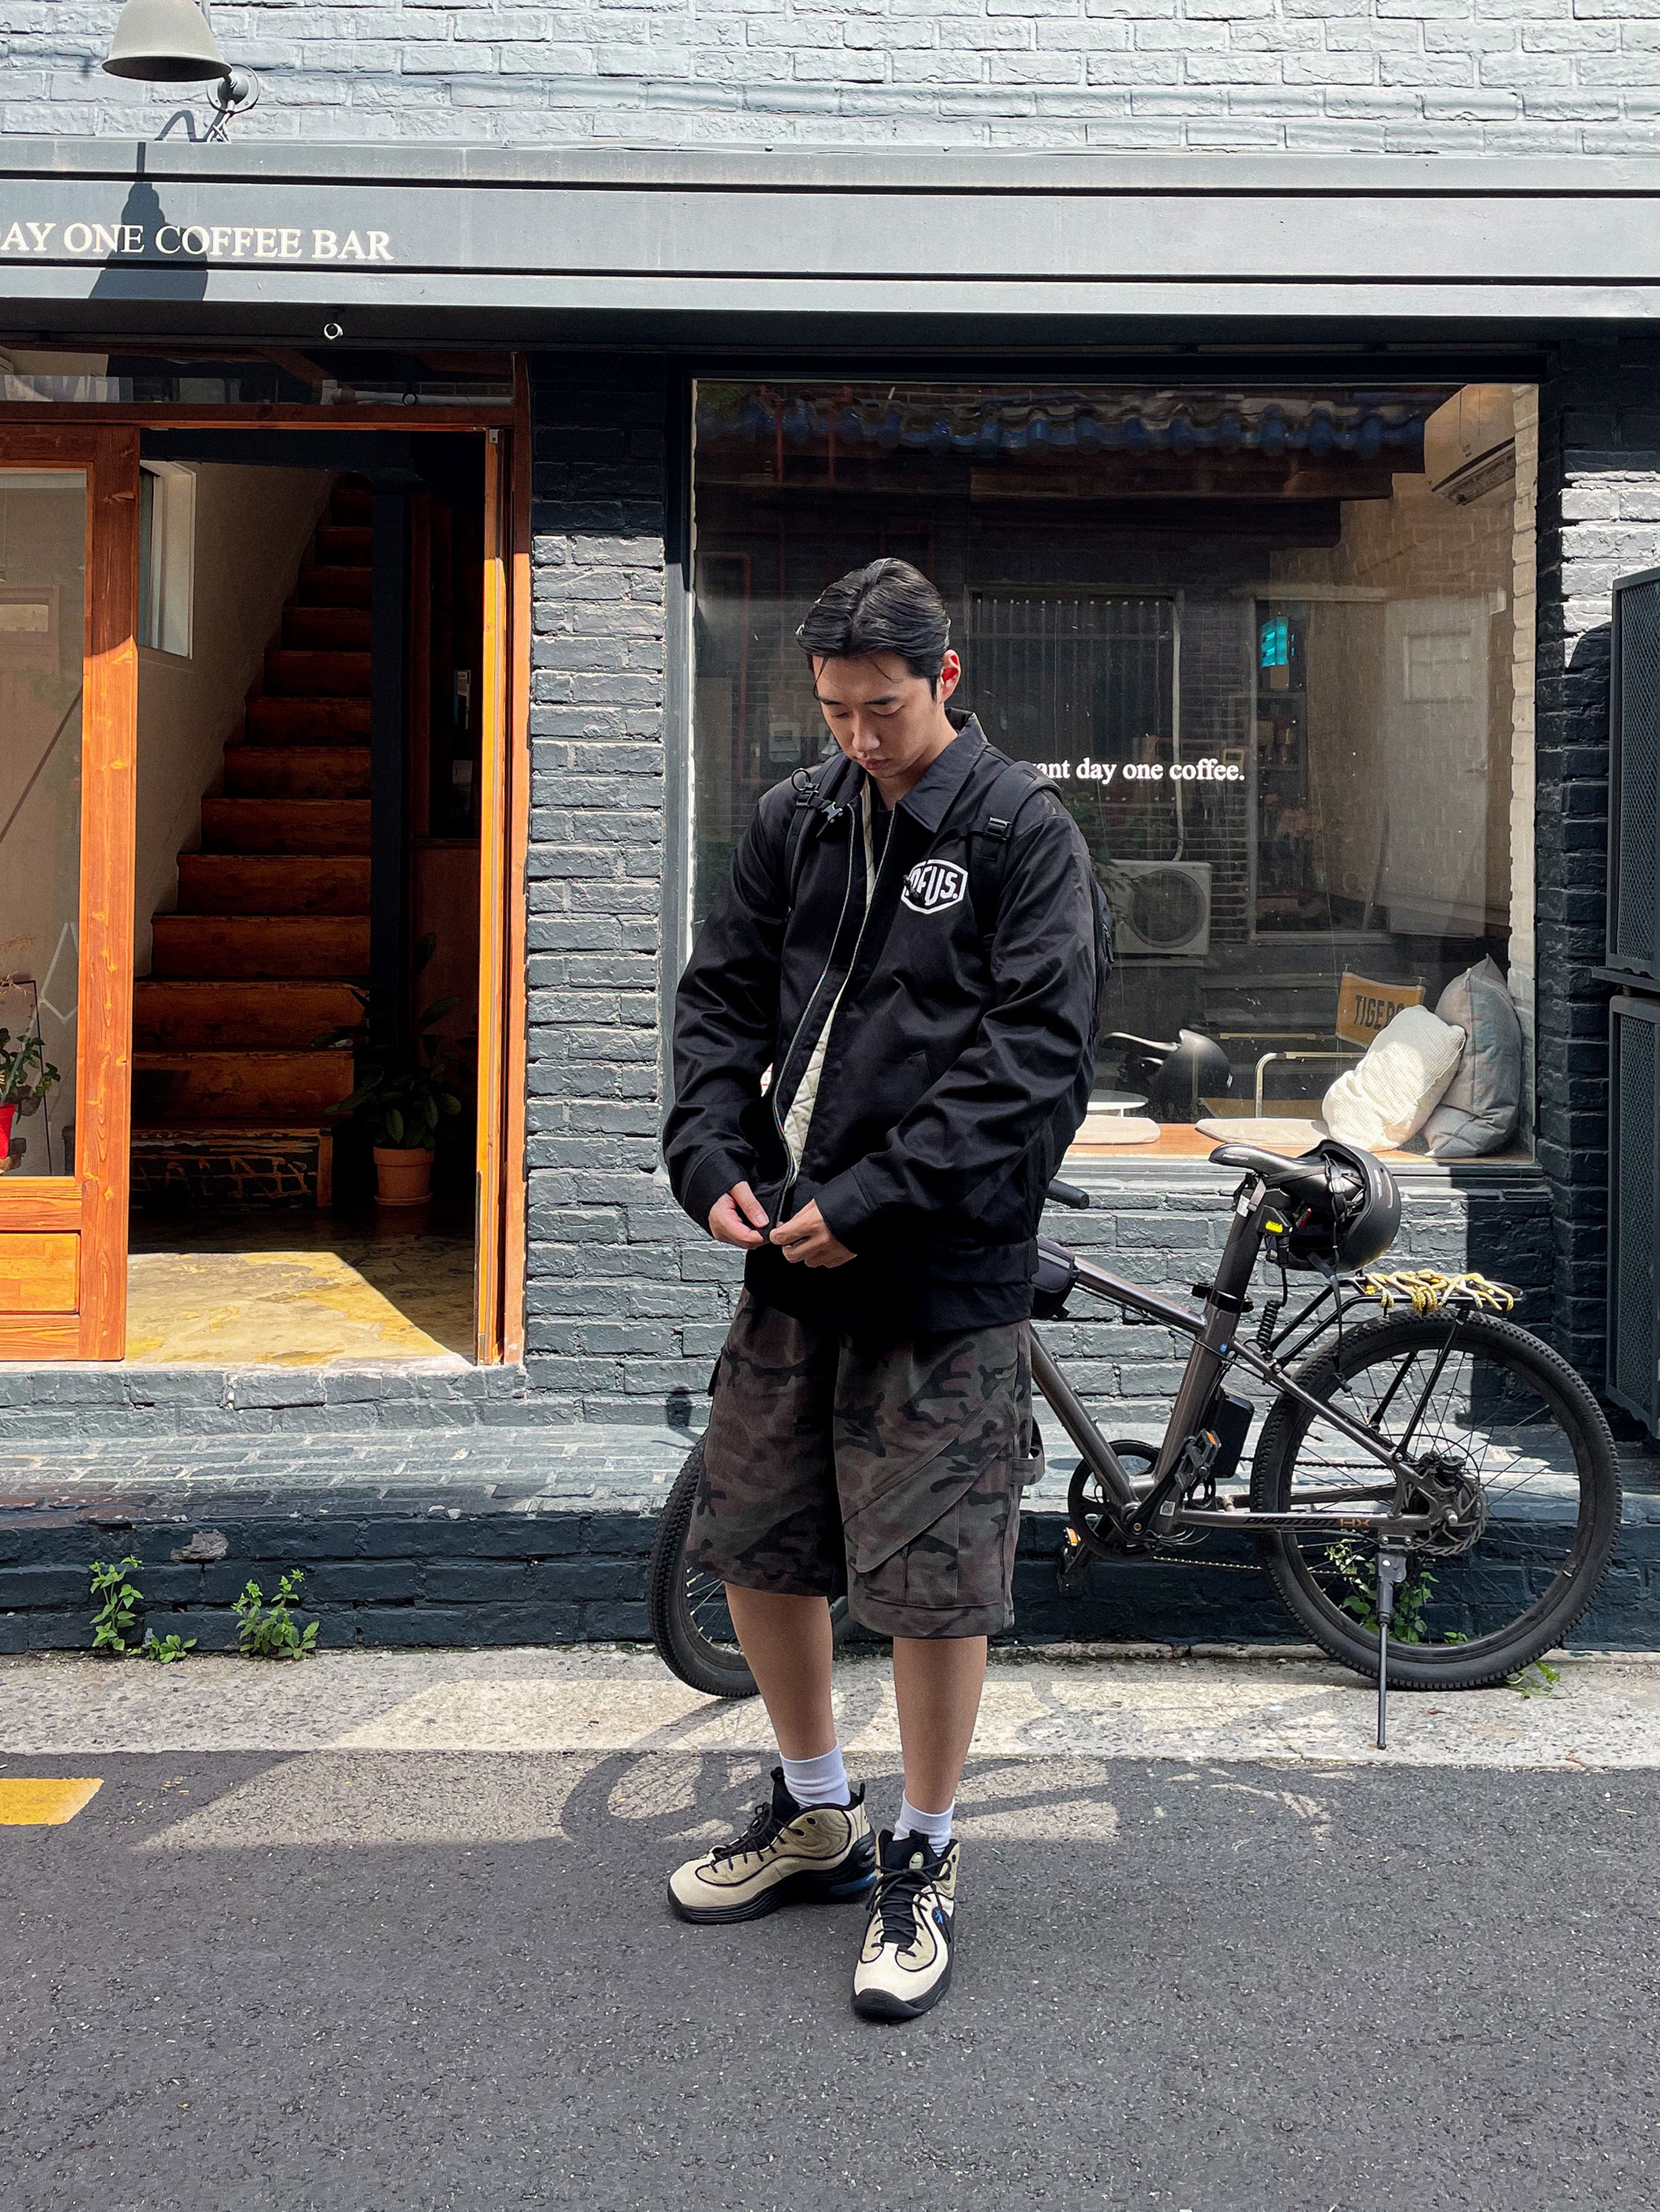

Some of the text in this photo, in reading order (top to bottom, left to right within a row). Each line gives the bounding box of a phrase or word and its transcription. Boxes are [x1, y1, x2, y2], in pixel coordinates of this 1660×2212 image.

[0, 222, 395, 260] AY ONE COFFEE BAR
[1032, 757, 1245, 785] ant day one coffee.
[1243, 1516, 1371, 1527] PHANTOM HX
